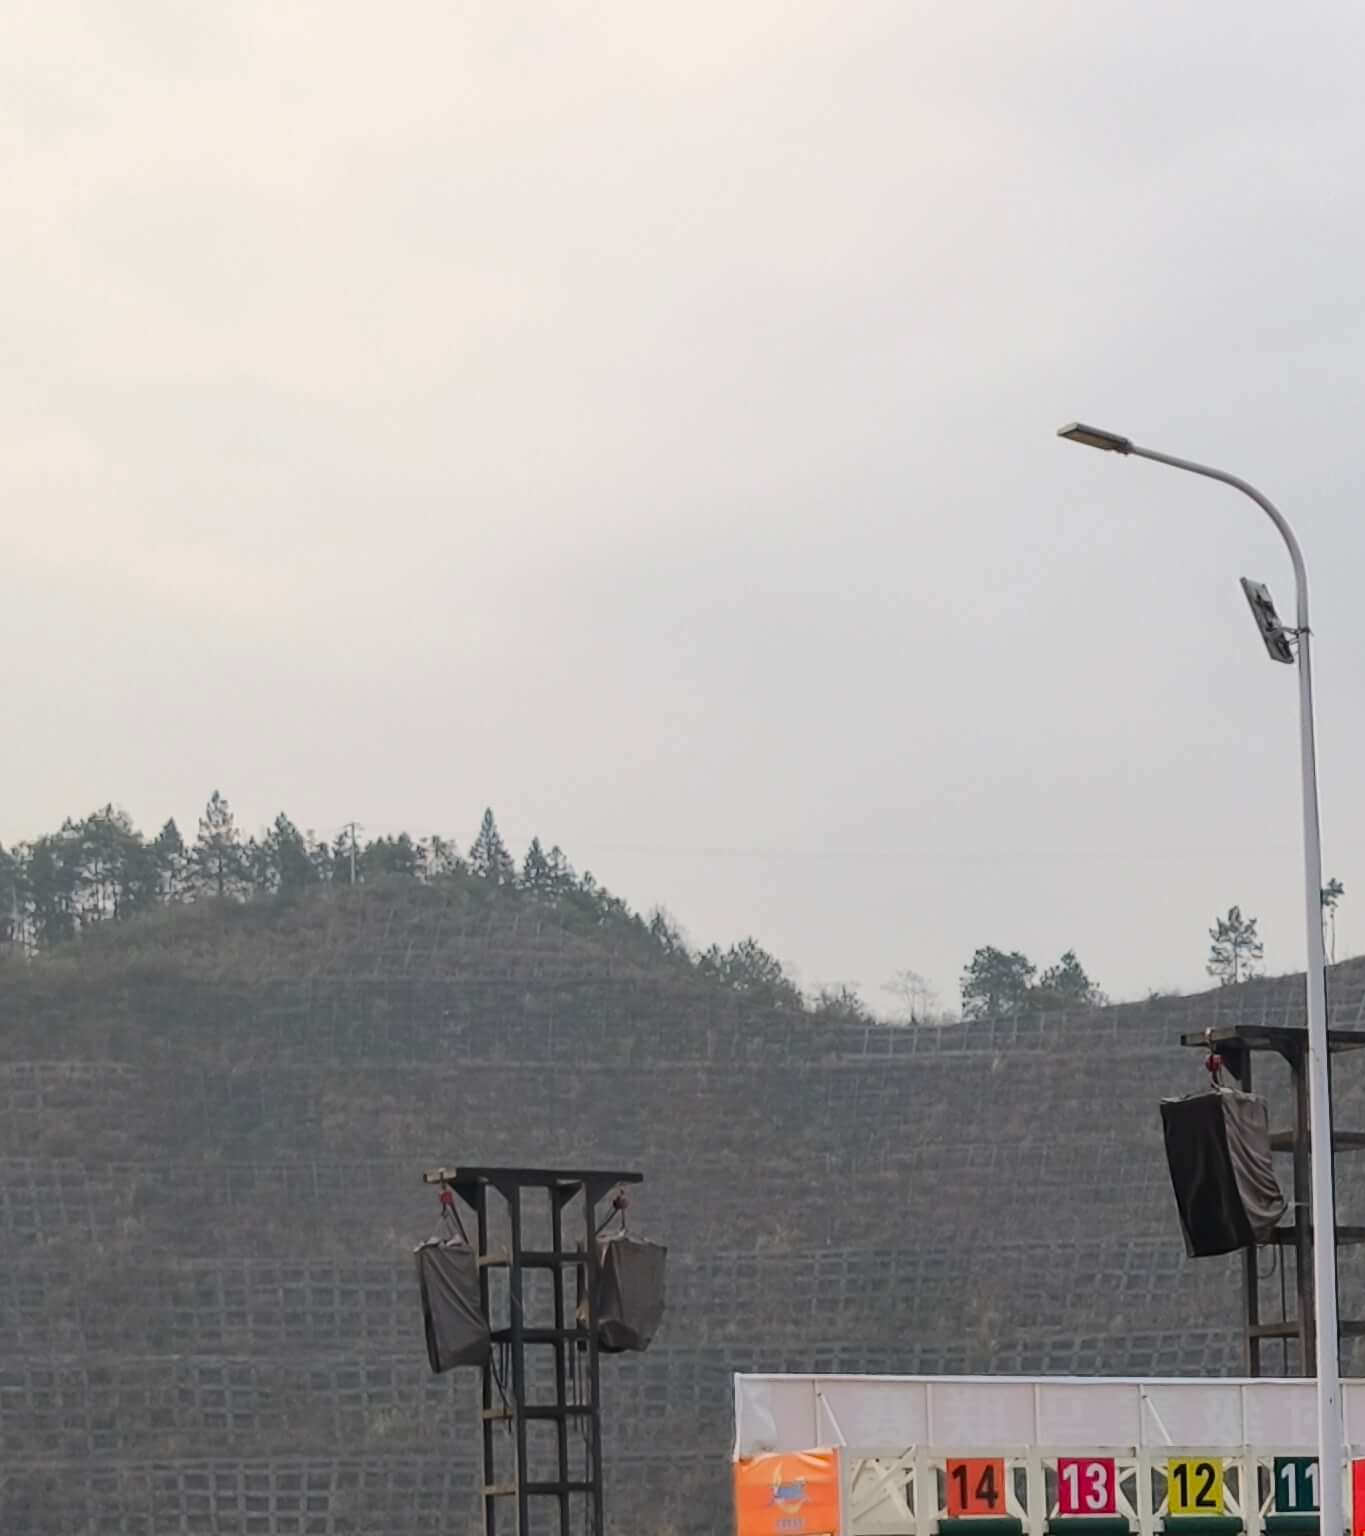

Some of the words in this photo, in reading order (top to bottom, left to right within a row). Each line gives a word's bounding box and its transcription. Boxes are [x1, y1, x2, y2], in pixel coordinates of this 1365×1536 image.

[951, 1464, 999, 1511] 14
[1062, 1462, 1109, 1511] 13
[1172, 1462, 1217, 1508] 12
[1280, 1462, 1320, 1508] 11
